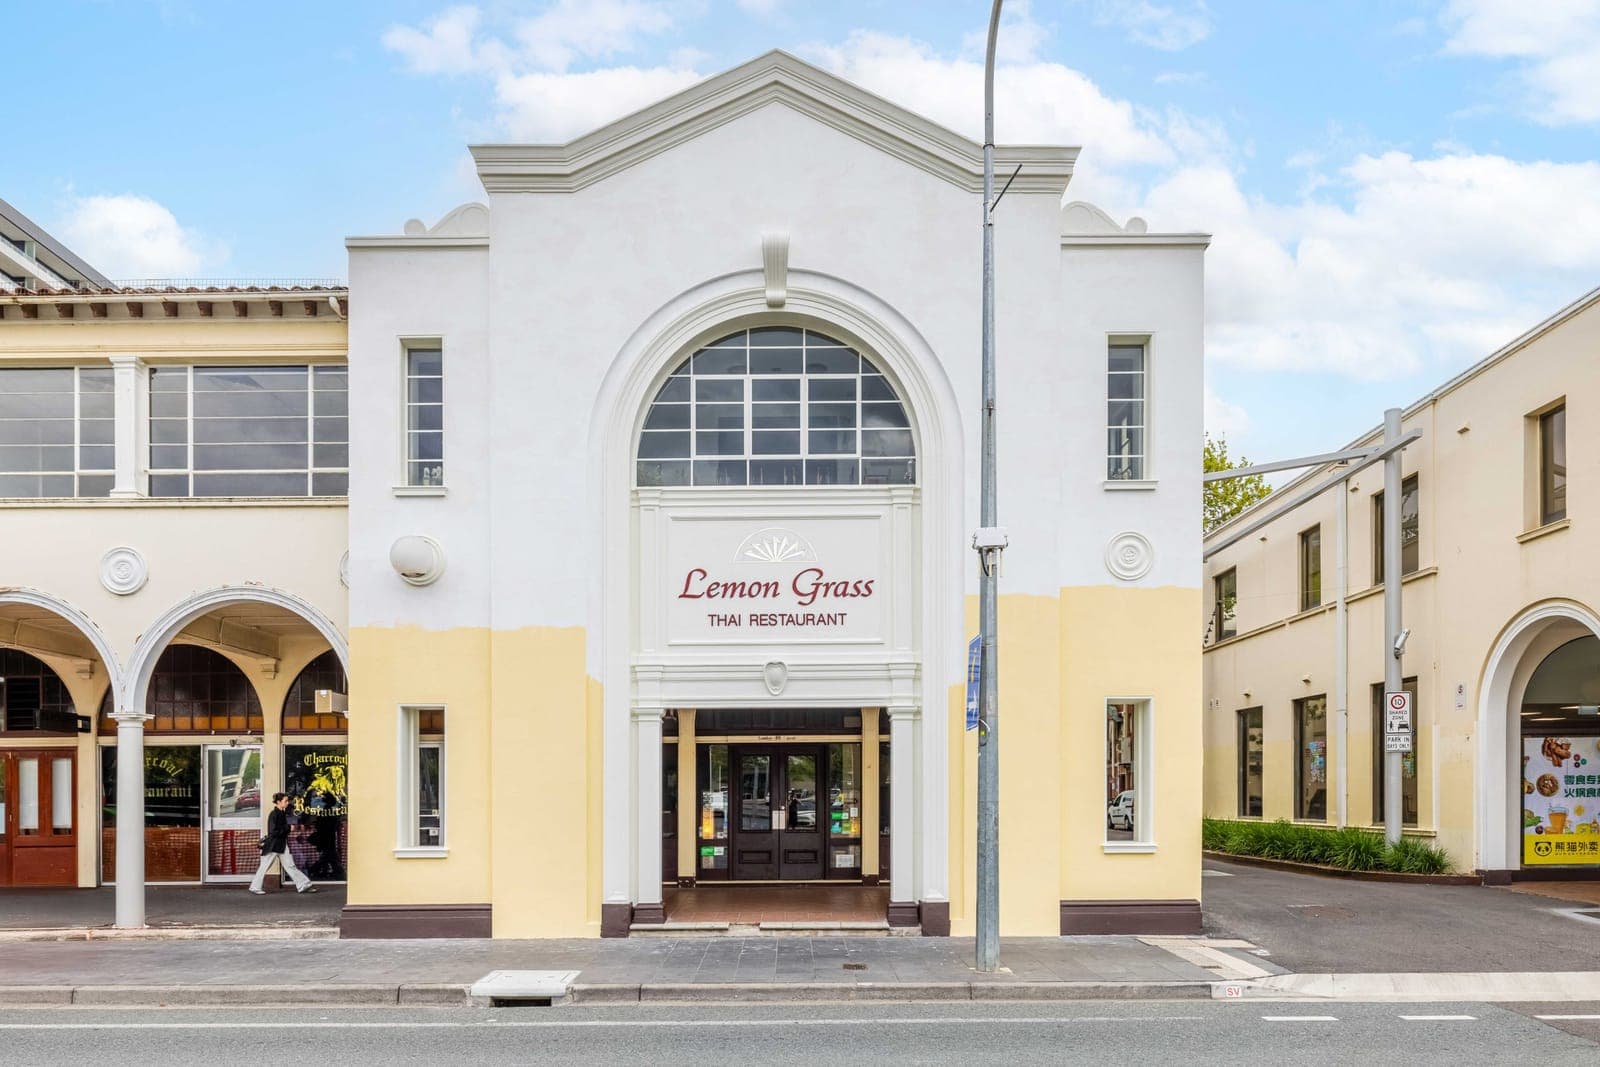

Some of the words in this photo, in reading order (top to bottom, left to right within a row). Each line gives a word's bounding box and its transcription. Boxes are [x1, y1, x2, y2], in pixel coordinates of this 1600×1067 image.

[678, 567, 780, 599] Lemon
[791, 567, 875, 606] Grass
[707, 614, 742, 627] THAI
[749, 613, 848, 626] RESTAURANT
[293, 796, 348, 817] Restaura
[1227, 987, 1240, 996] SV
